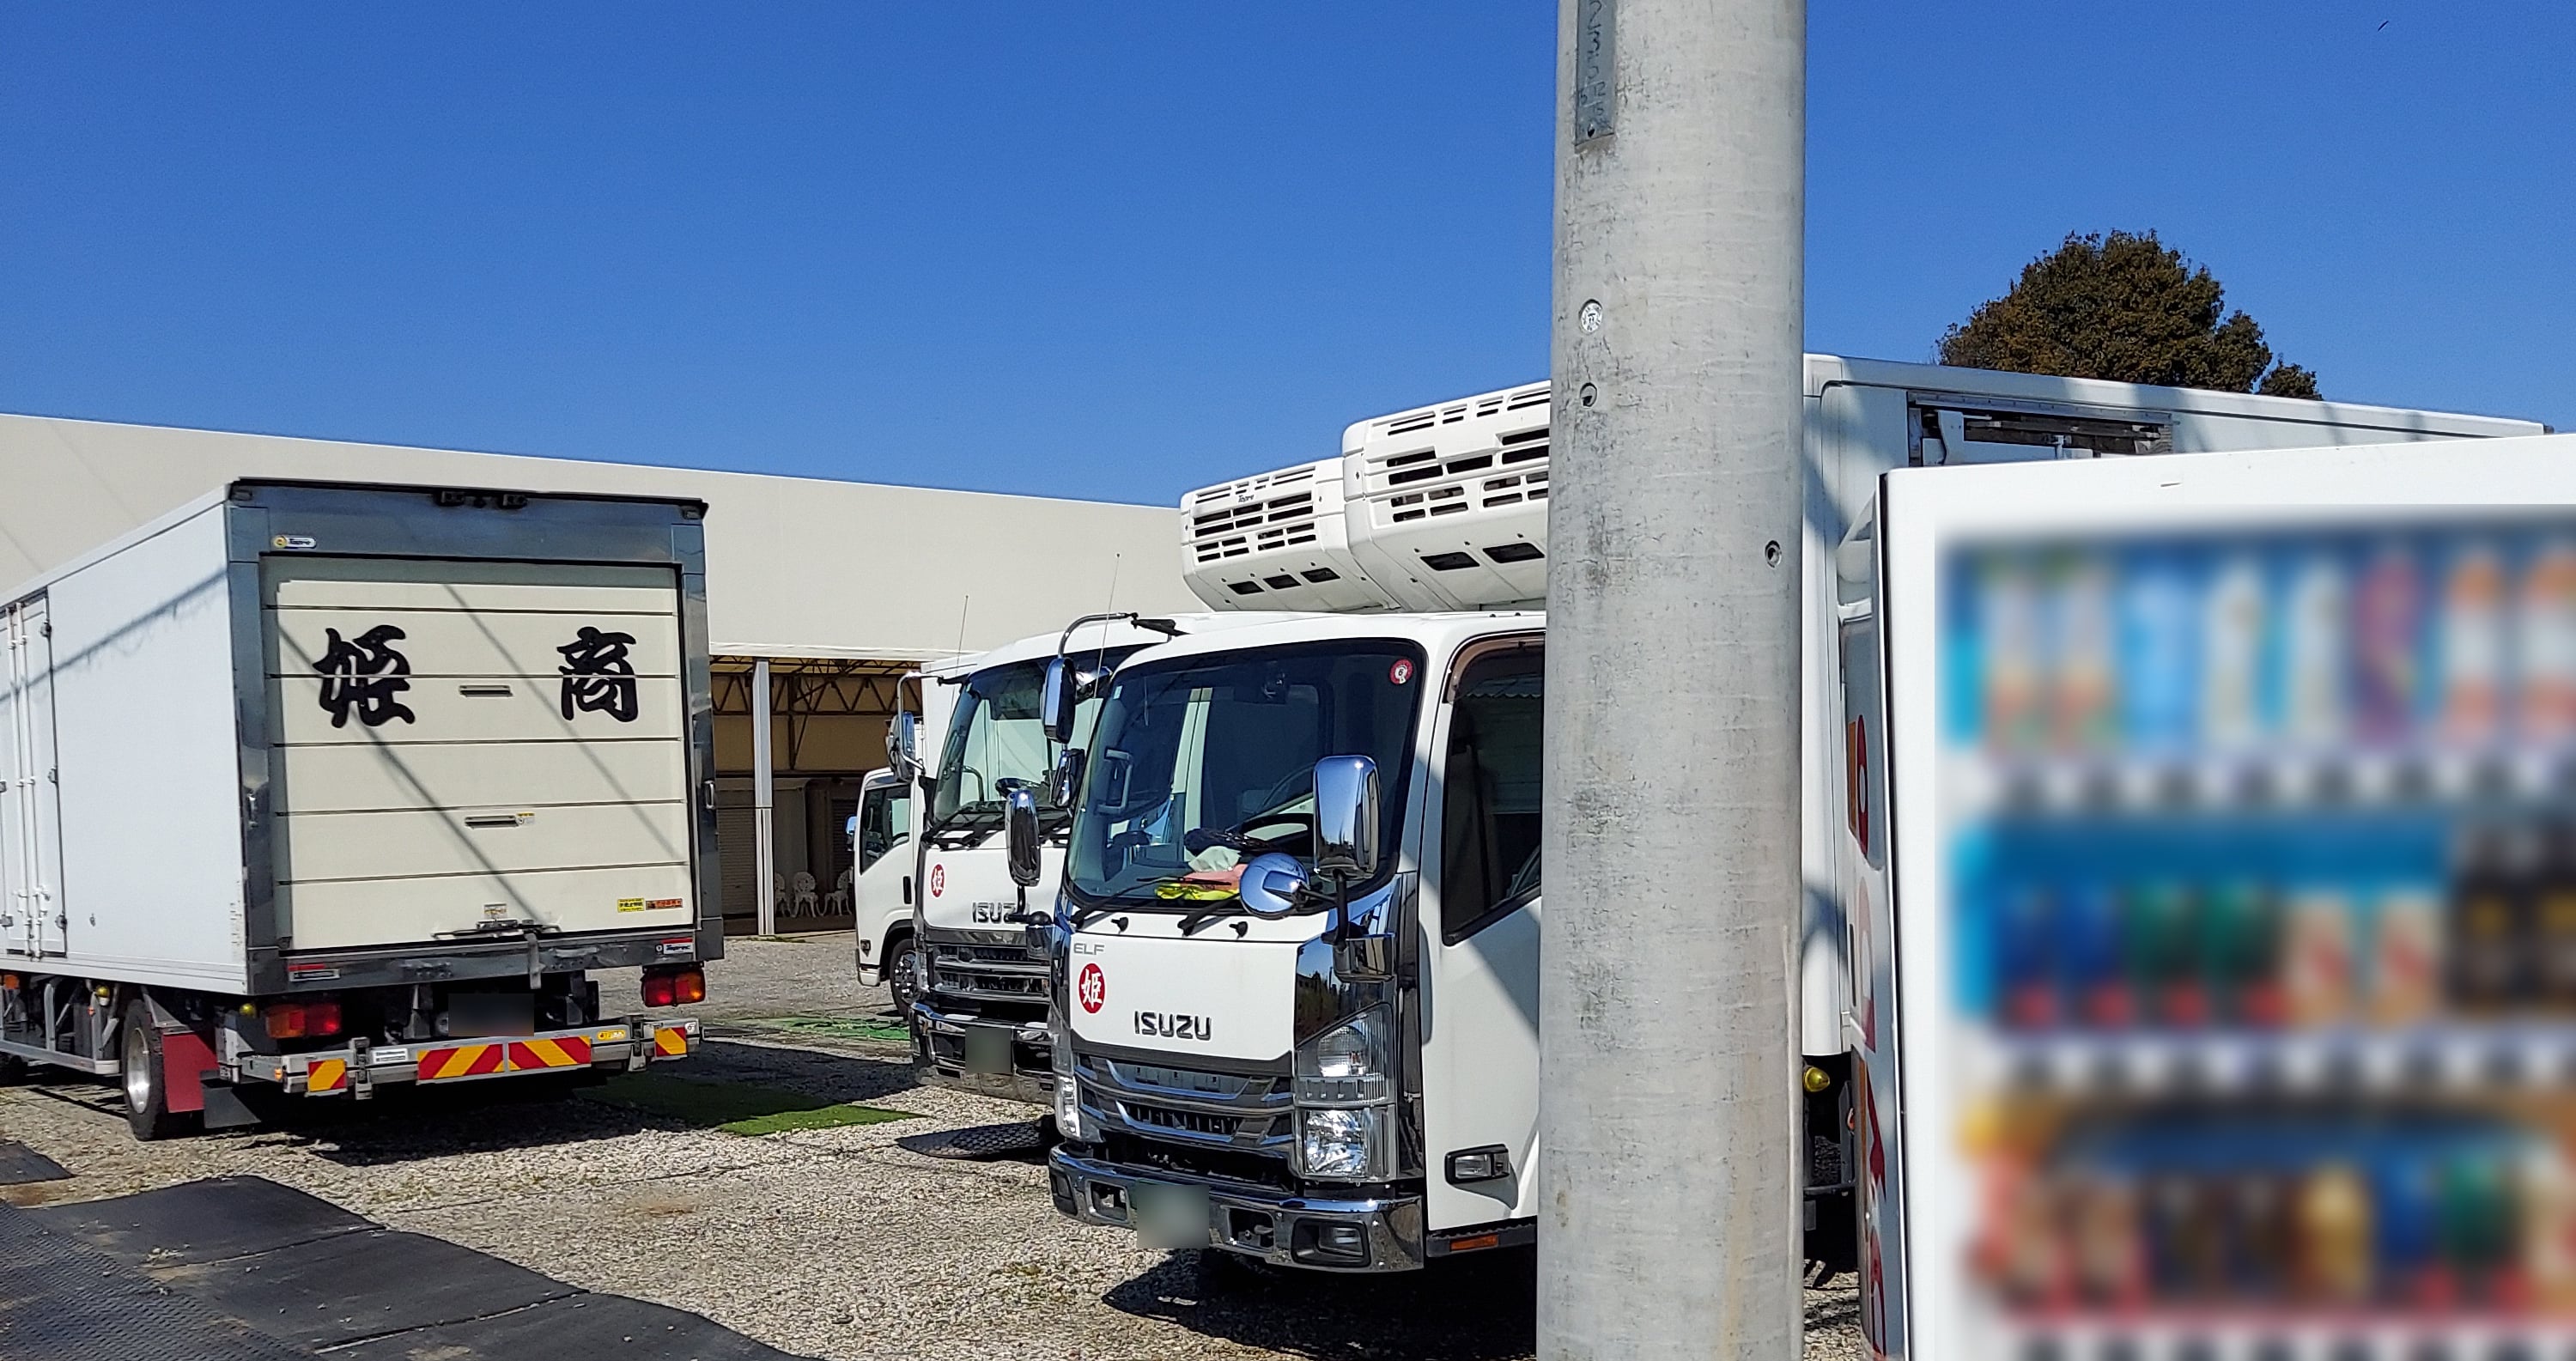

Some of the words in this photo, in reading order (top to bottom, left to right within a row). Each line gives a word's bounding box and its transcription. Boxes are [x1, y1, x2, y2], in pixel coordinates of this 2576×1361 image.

[556, 626, 638, 722] 商
[972, 902, 1030, 924] ISUZ
[1073, 943, 1105, 955] ELF
[1080, 967, 1103, 1009] 姫
[1133, 1010, 1212, 1042] ISUZU
